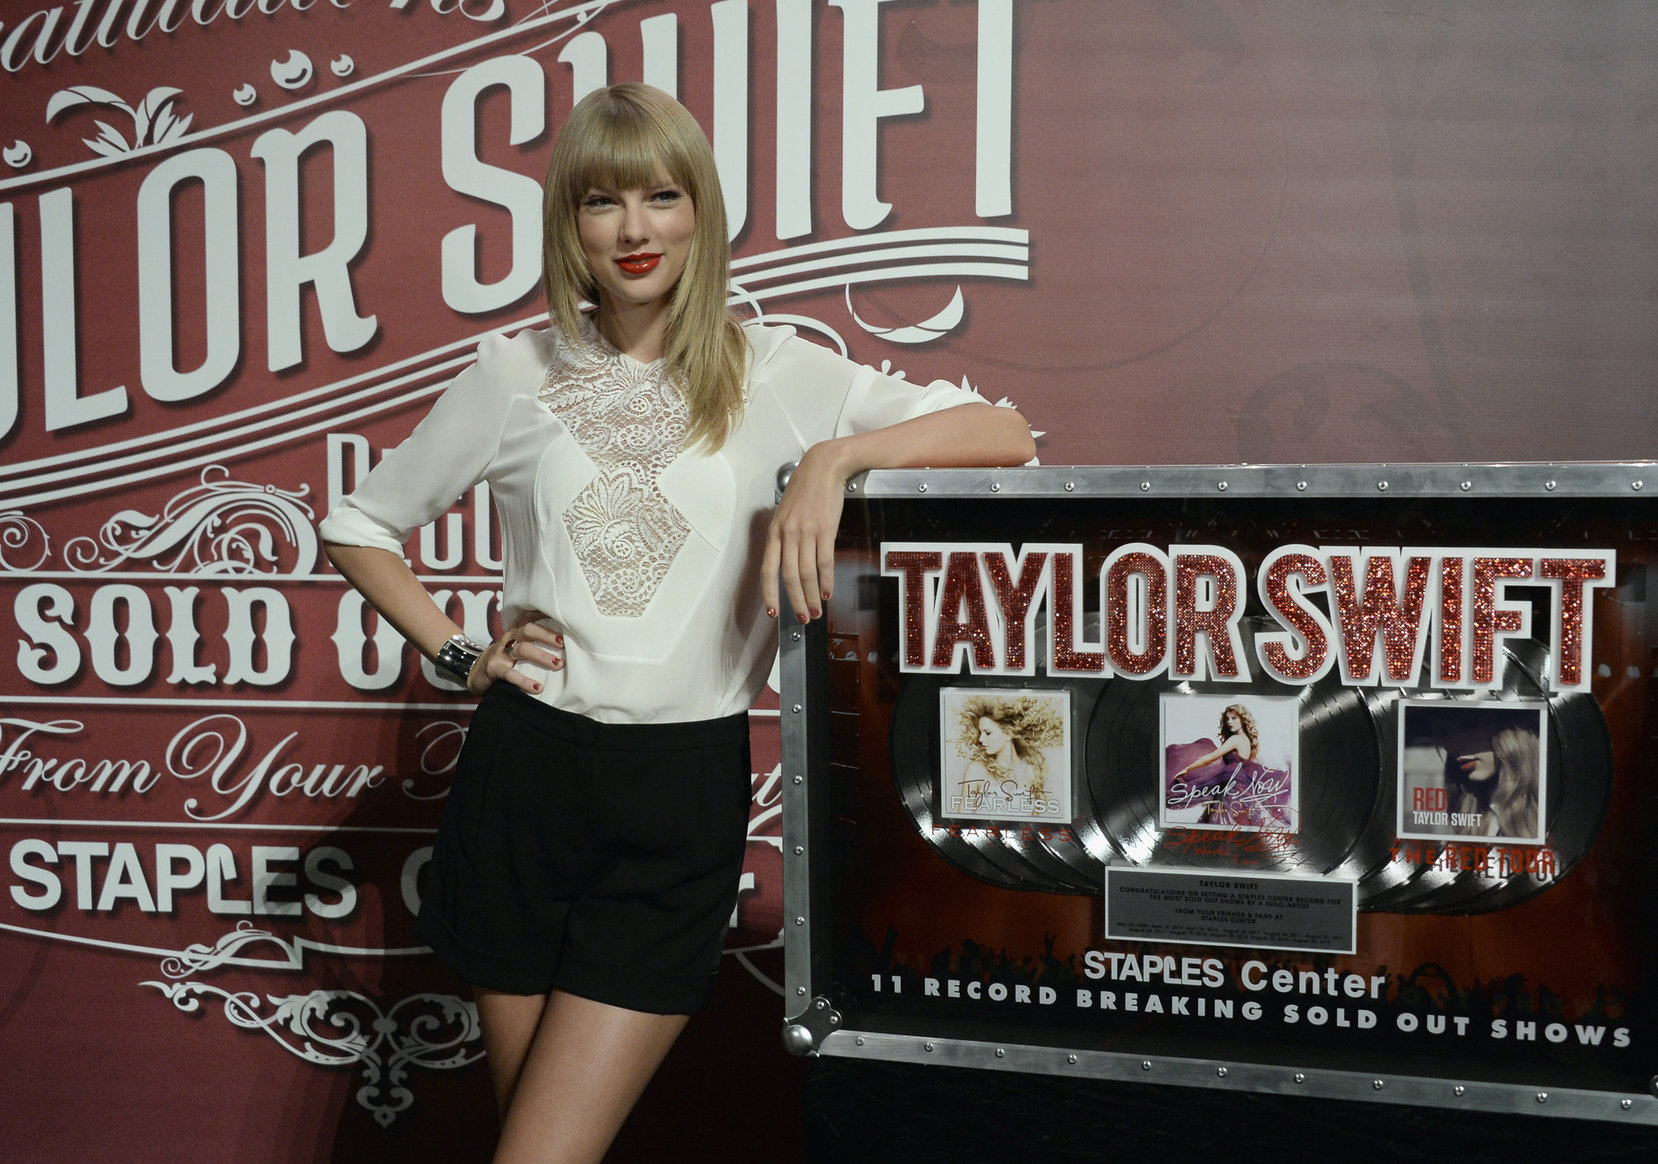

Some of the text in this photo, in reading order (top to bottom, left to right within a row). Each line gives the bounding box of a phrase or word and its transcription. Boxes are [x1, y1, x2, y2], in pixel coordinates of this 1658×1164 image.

[0, 108, 378, 440] LOR
[14, 582, 296, 686] SOLD
[881, 542, 1617, 693] TAYLOR SWIFT
[0, 717, 161, 794] From
[165, 714, 386, 821] Your
[1167, 762, 1289, 808] Speak Now
[950, 795, 1061, 815] FEARLESS
[1412, 811, 1482, 827] TAYLOR SWIFT
[1413, 786, 1447, 812] RED
[931, 823, 1073, 843] FEARLESS
[9, 838, 358, 919] STAPLES
[1199, 880, 1230, 888] TAYLOR
[1389, 846, 1556, 875] THE RED TOUR
[1083, 951, 1386, 999] STAPLES Center
[871, 974, 1632, 1049] 11 RECORD BREAKING SOLD OUT SHOWS
